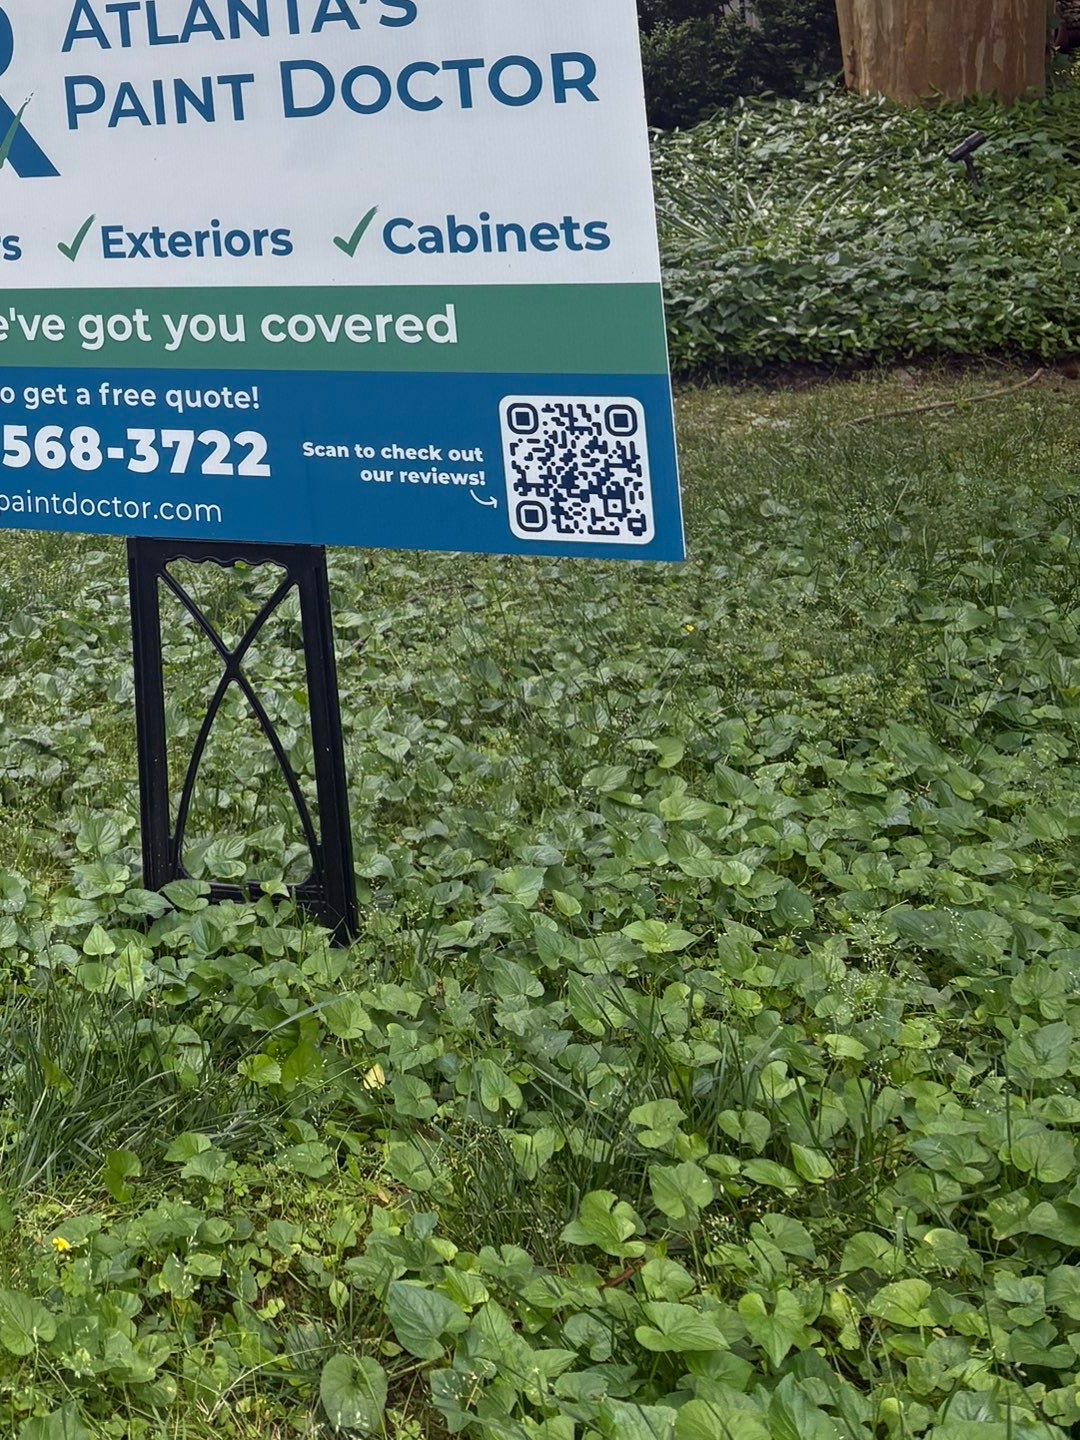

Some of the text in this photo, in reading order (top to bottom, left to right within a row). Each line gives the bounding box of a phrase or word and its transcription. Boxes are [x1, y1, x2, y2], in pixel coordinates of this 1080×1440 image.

[64, 51, 600, 130] PAINT DOCTOR
[100, 218, 294, 260] Exteriors
[382, 211, 611, 255] Cabinets
[78, 308, 151, 351] got
[162, 313, 247, 351] you
[260, 303, 458, 344] covered
[23, 384, 68, 410] get
[76, 386, 91, 406] a
[98, 381, 157, 408] free
[165, 386, 260, 413] quote!
[2, 424, 271, 477] 568-3722
[302, 441, 484, 462] Scan to check out
[360, 468, 486, 486] our reviews!
